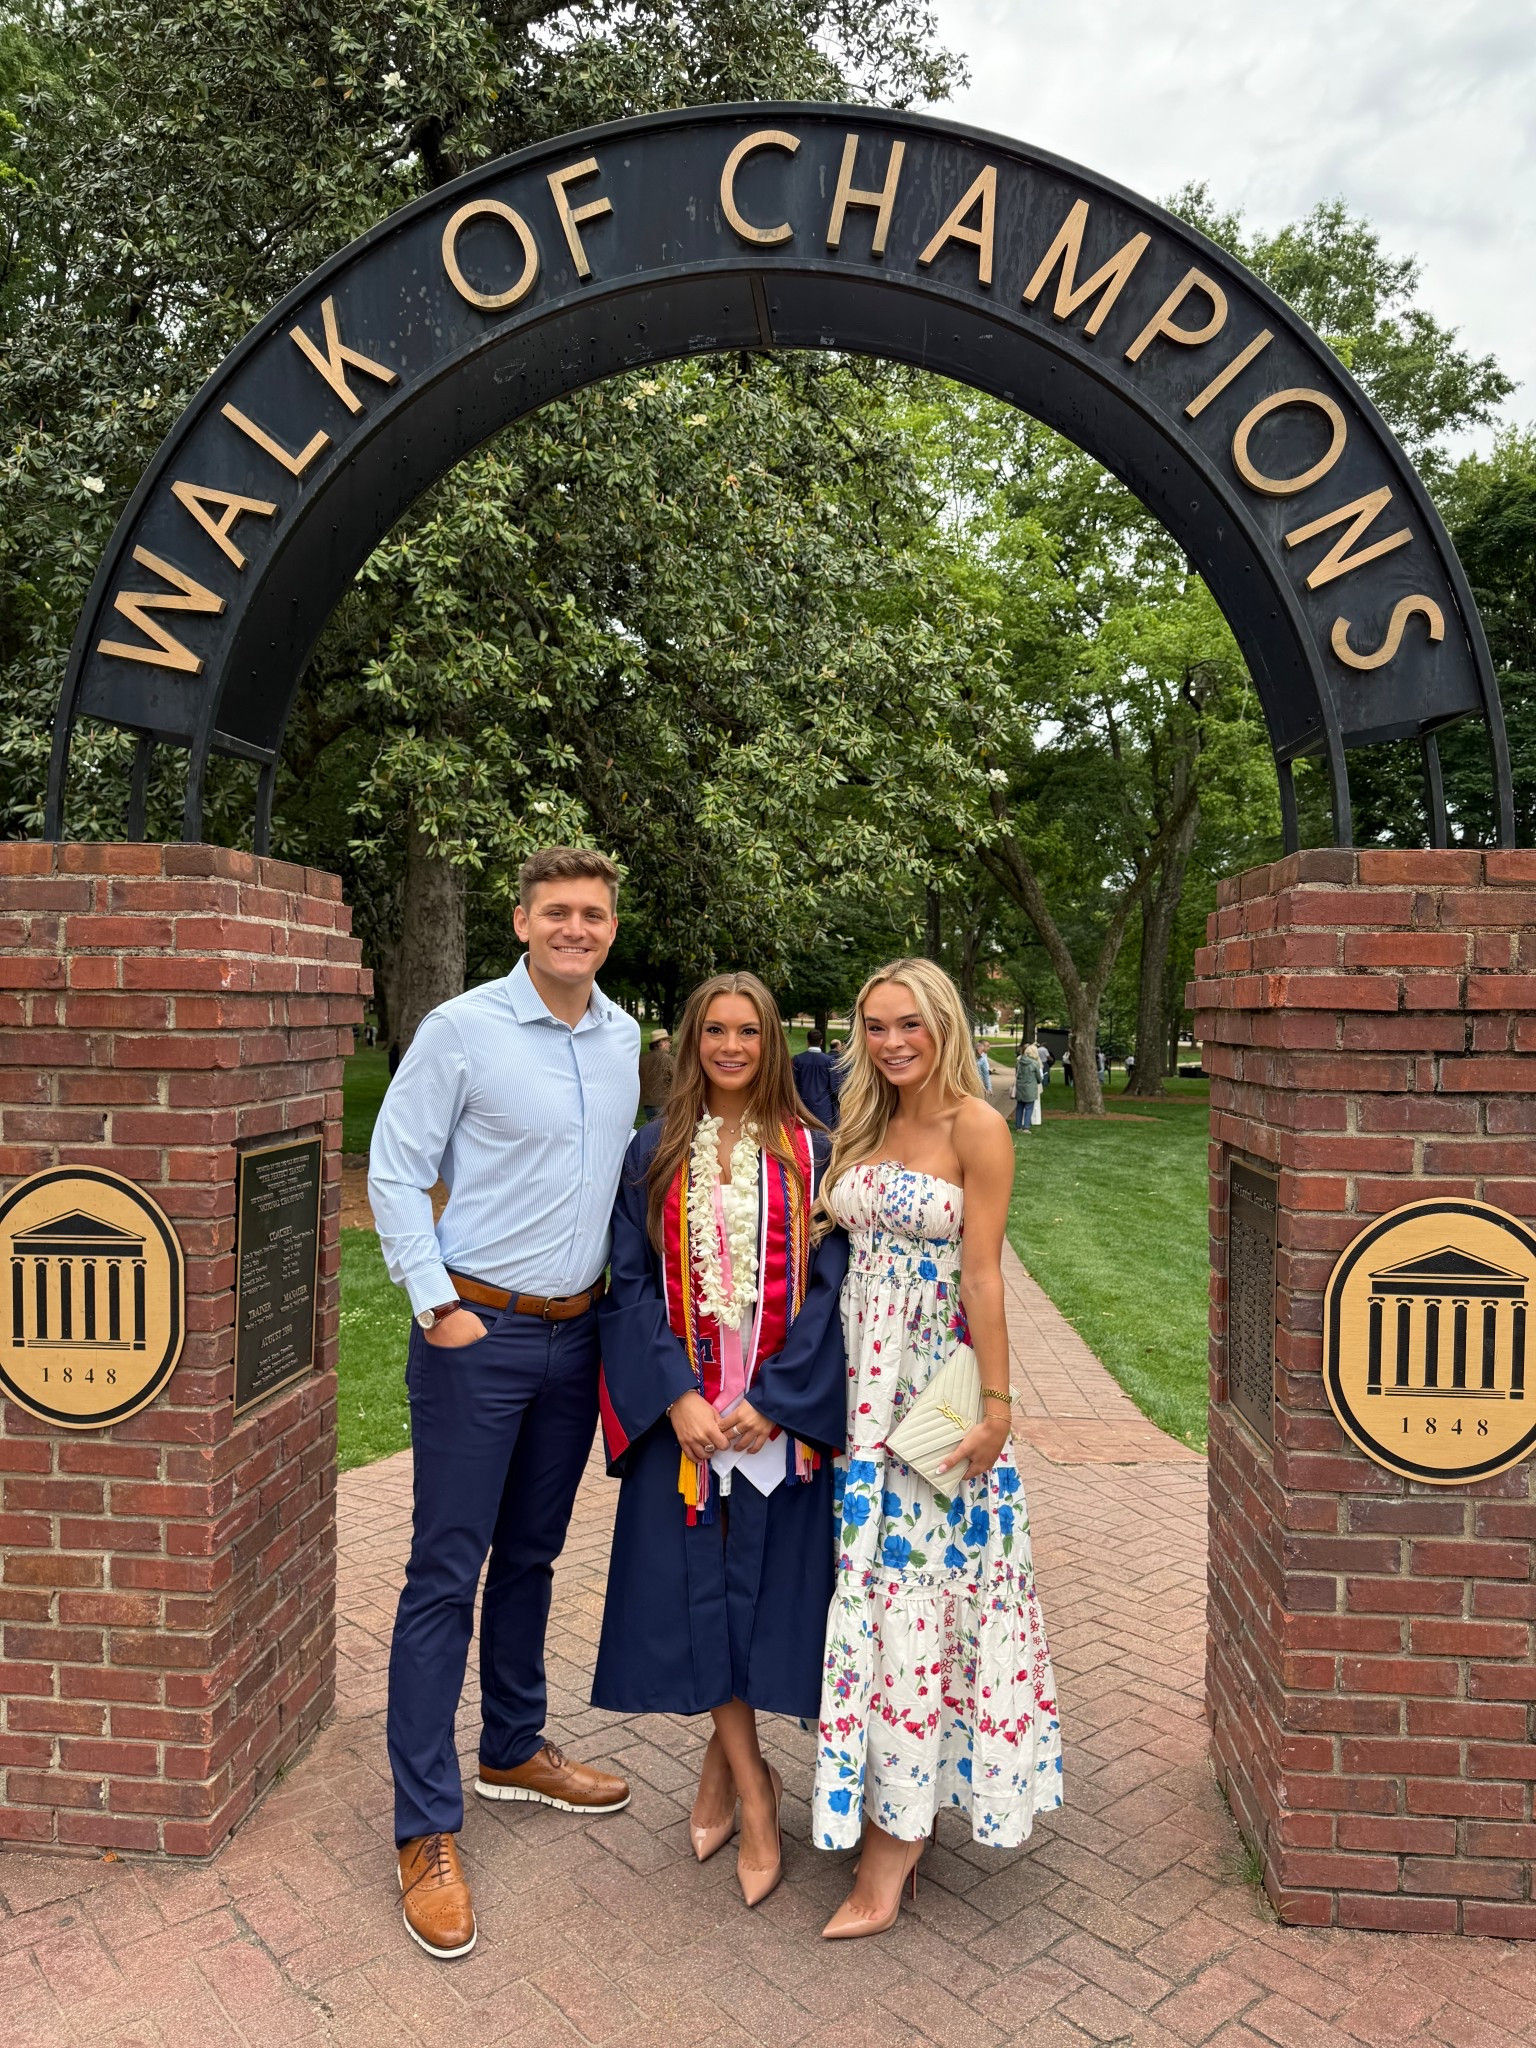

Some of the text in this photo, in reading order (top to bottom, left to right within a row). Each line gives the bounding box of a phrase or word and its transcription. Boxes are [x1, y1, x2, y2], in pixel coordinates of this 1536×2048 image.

[97, 130, 1446, 675] WALK OF CHAMPIONS
[42, 1367, 117, 1384] 1848
[1400, 1416, 1489, 1437] 1848
